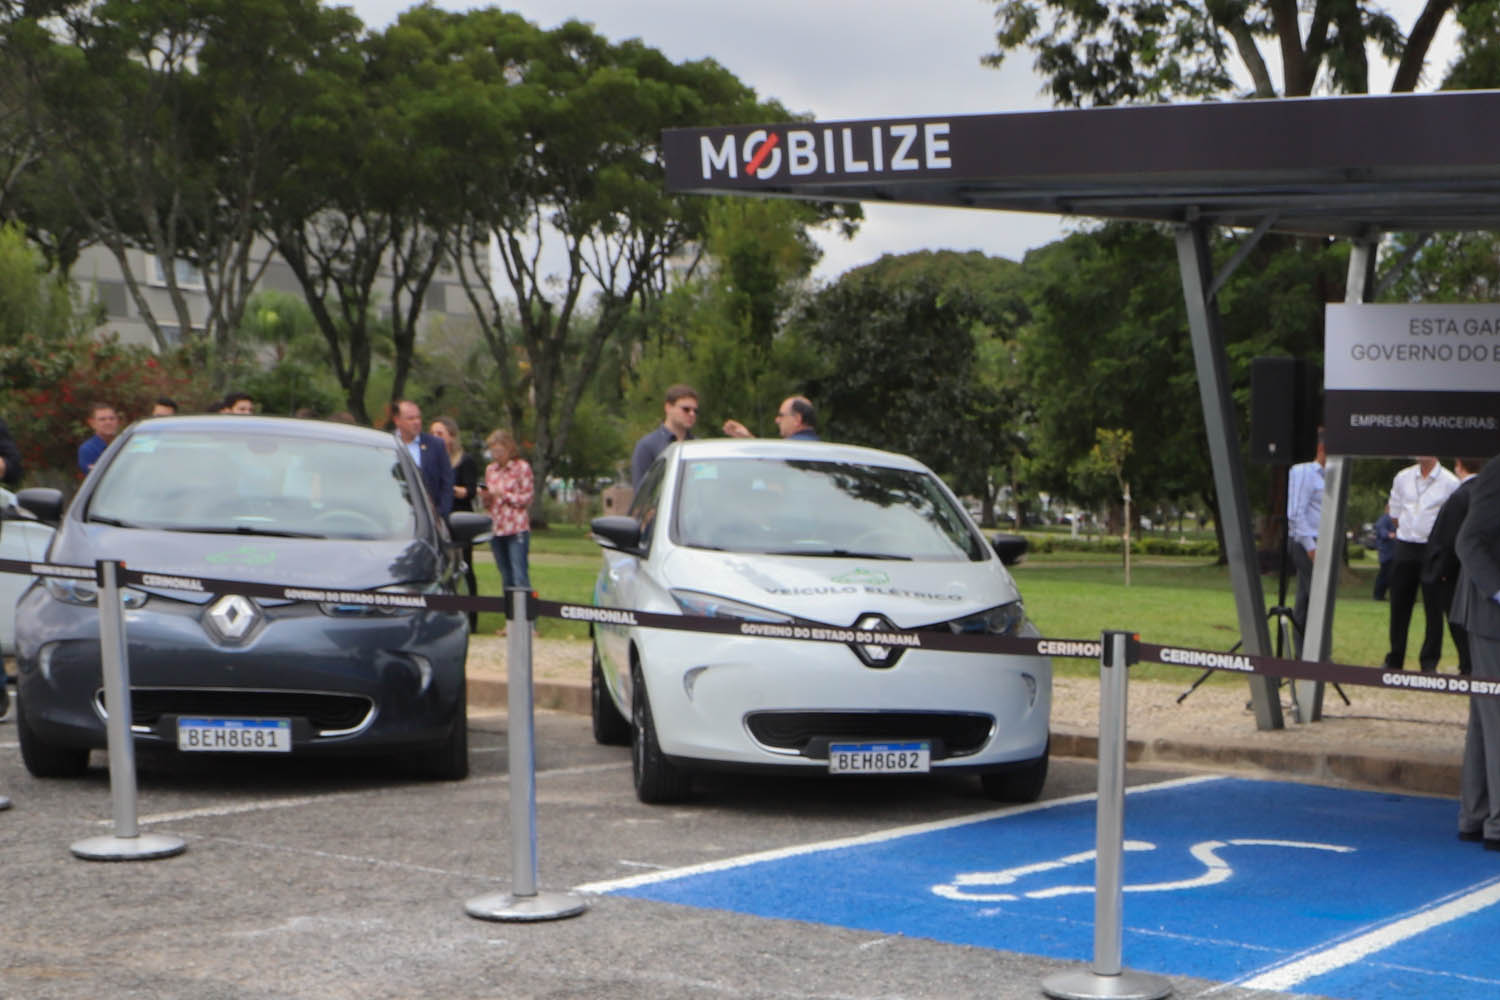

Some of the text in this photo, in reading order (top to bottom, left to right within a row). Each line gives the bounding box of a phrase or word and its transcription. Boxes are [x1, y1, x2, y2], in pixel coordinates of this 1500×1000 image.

[700, 122, 952, 179] MOBILIZE
[1409, 318, 1458, 336] ESTA
[1350, 343, 1453, 361] GOVERNO
[1457, 344, 1488, 362] DO
[1350, 414, 1418, 428] EMPRESAS
[560, 604, 638, 625] CERIMONIAL
[741, 623, 921, 646] GOVERNO DO ESTADO DO PARANÁ
[1160, 648, 1254, 671] CERIMONIAL
[1382, 673, 1447, 690] GOVERNO
[1449, 678, 1469, 692] DO
[188, 729, 278, 748] BEH8G81
[839, 752, 919, 771] BEH8G82
